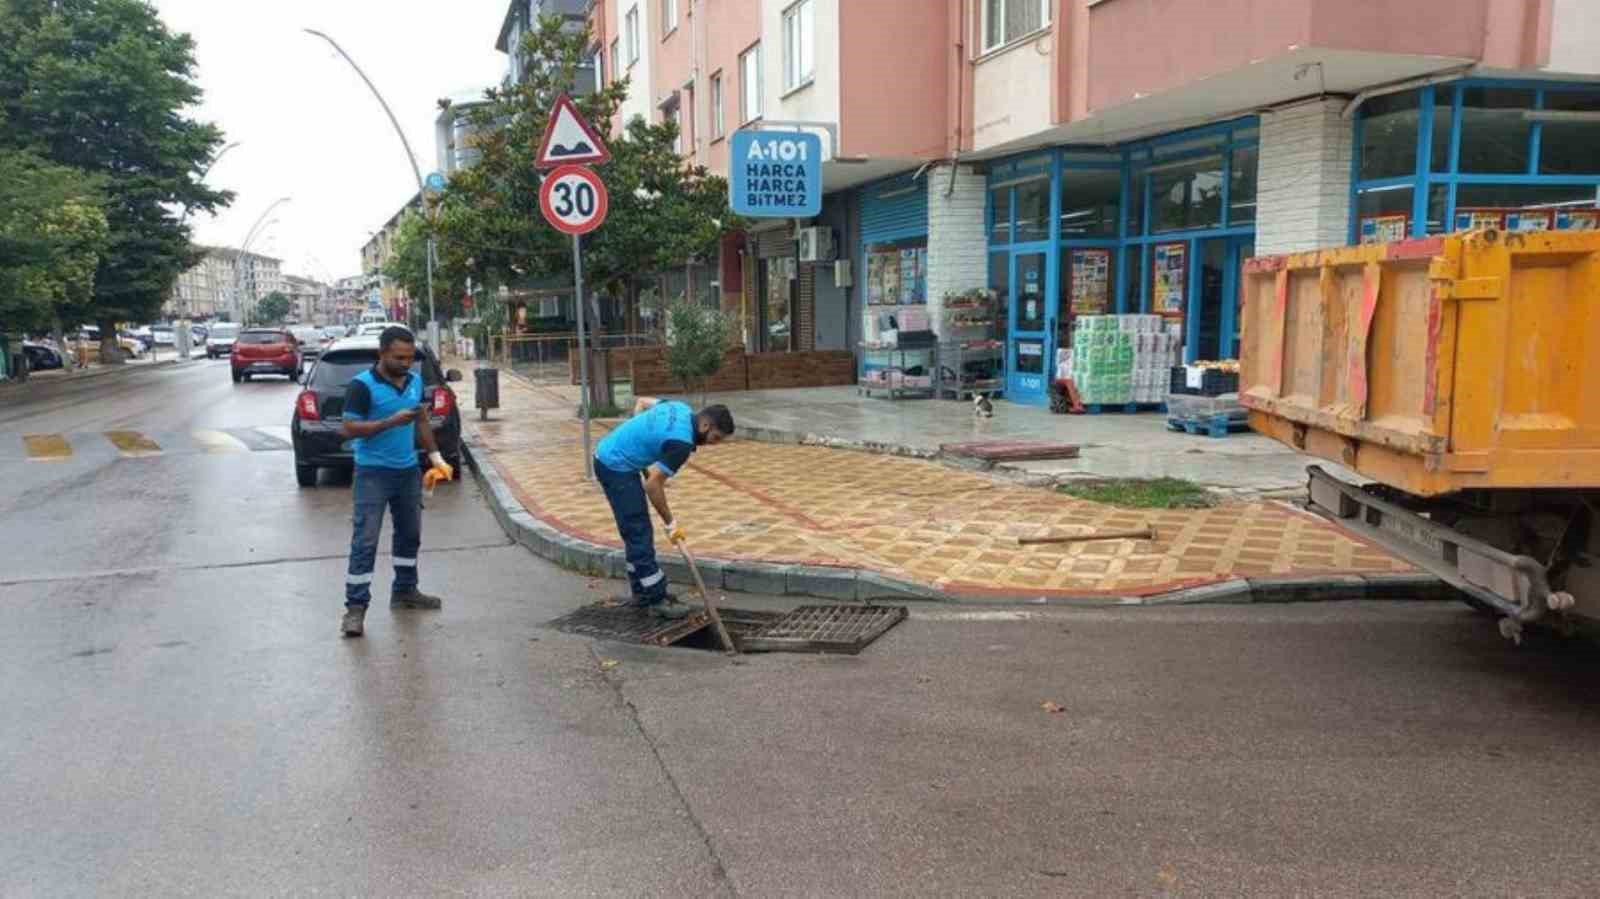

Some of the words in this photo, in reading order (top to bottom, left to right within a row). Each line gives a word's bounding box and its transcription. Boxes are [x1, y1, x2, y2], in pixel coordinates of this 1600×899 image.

[746, 164, 806, 177] HARCA
[747, 179, 806, 192] HARCA
[554, 182, 594, 217] 30
